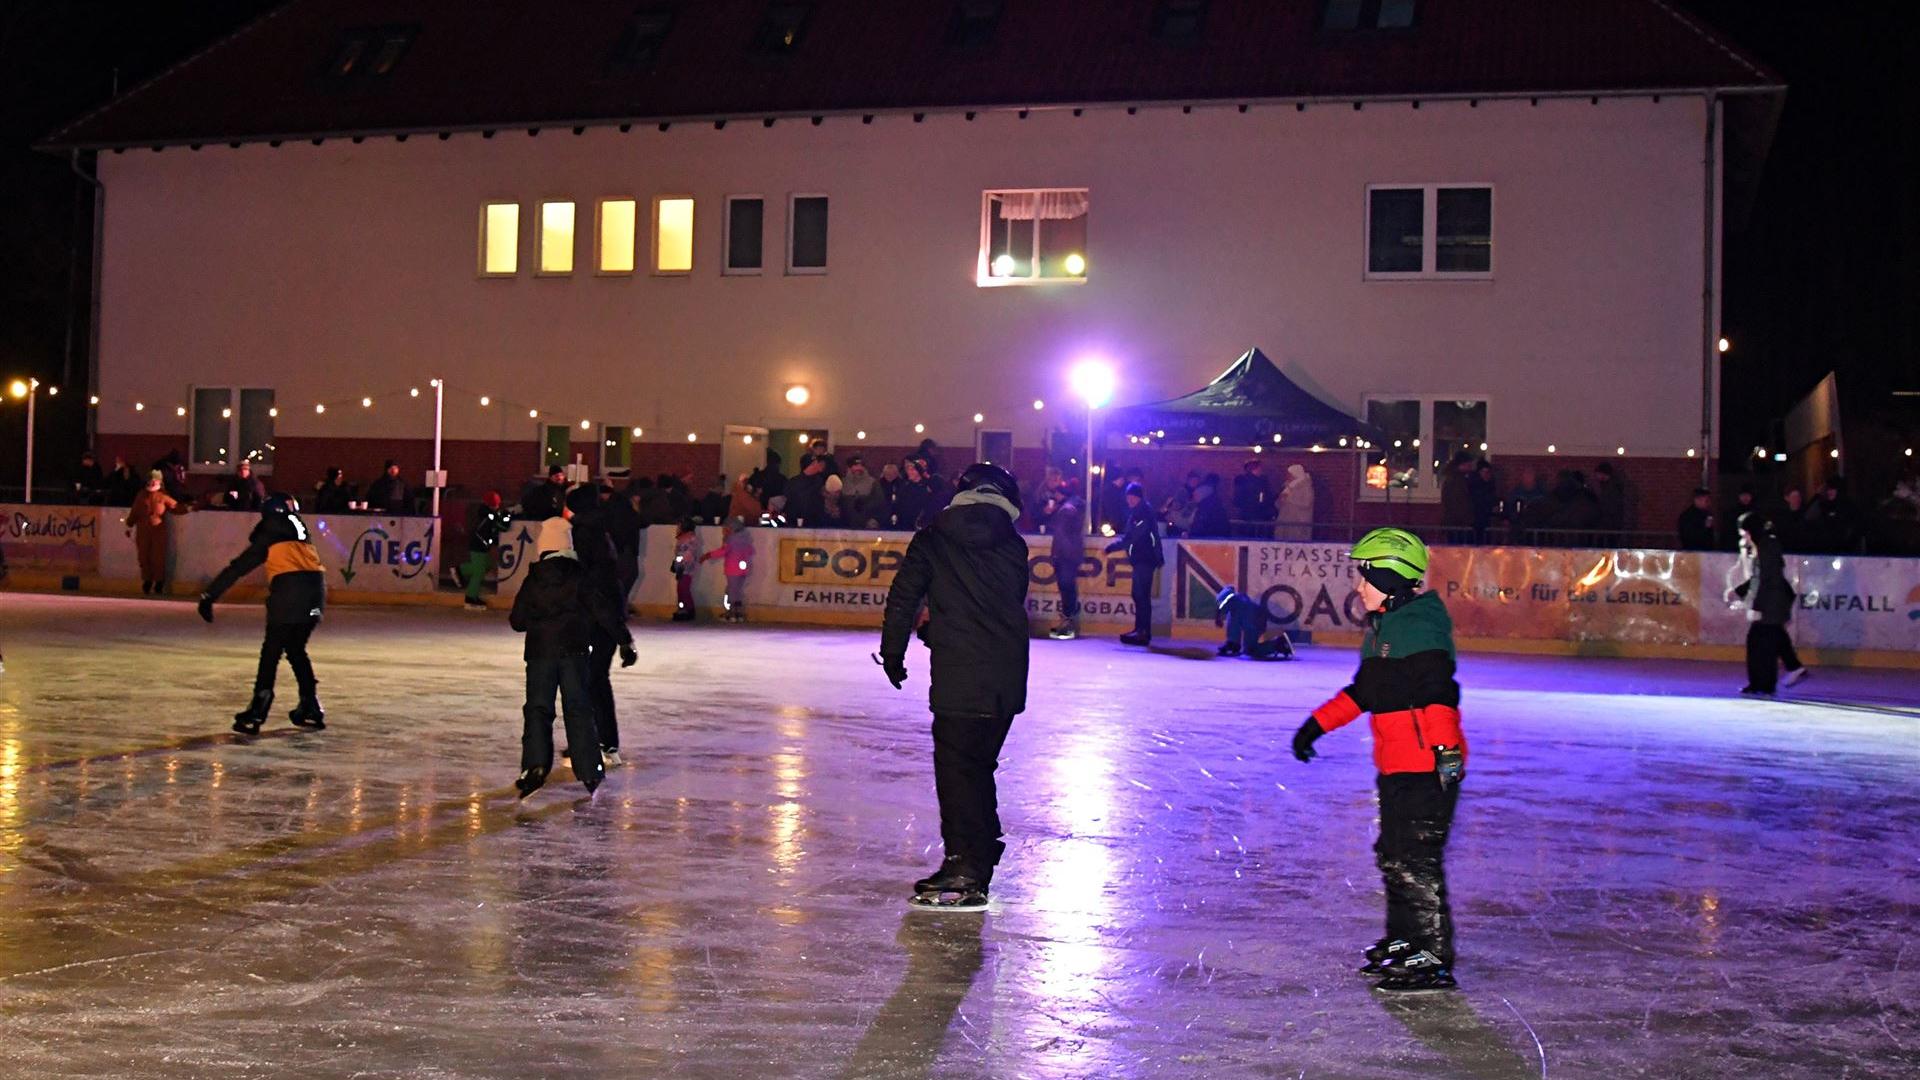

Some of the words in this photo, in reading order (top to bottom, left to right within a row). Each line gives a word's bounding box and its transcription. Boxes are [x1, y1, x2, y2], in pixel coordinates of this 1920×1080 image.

[363, 539, 423, 566] NEG
[1531, 583, 1560, 602] für
[1605, 586, 1682, 606] Lausitz
